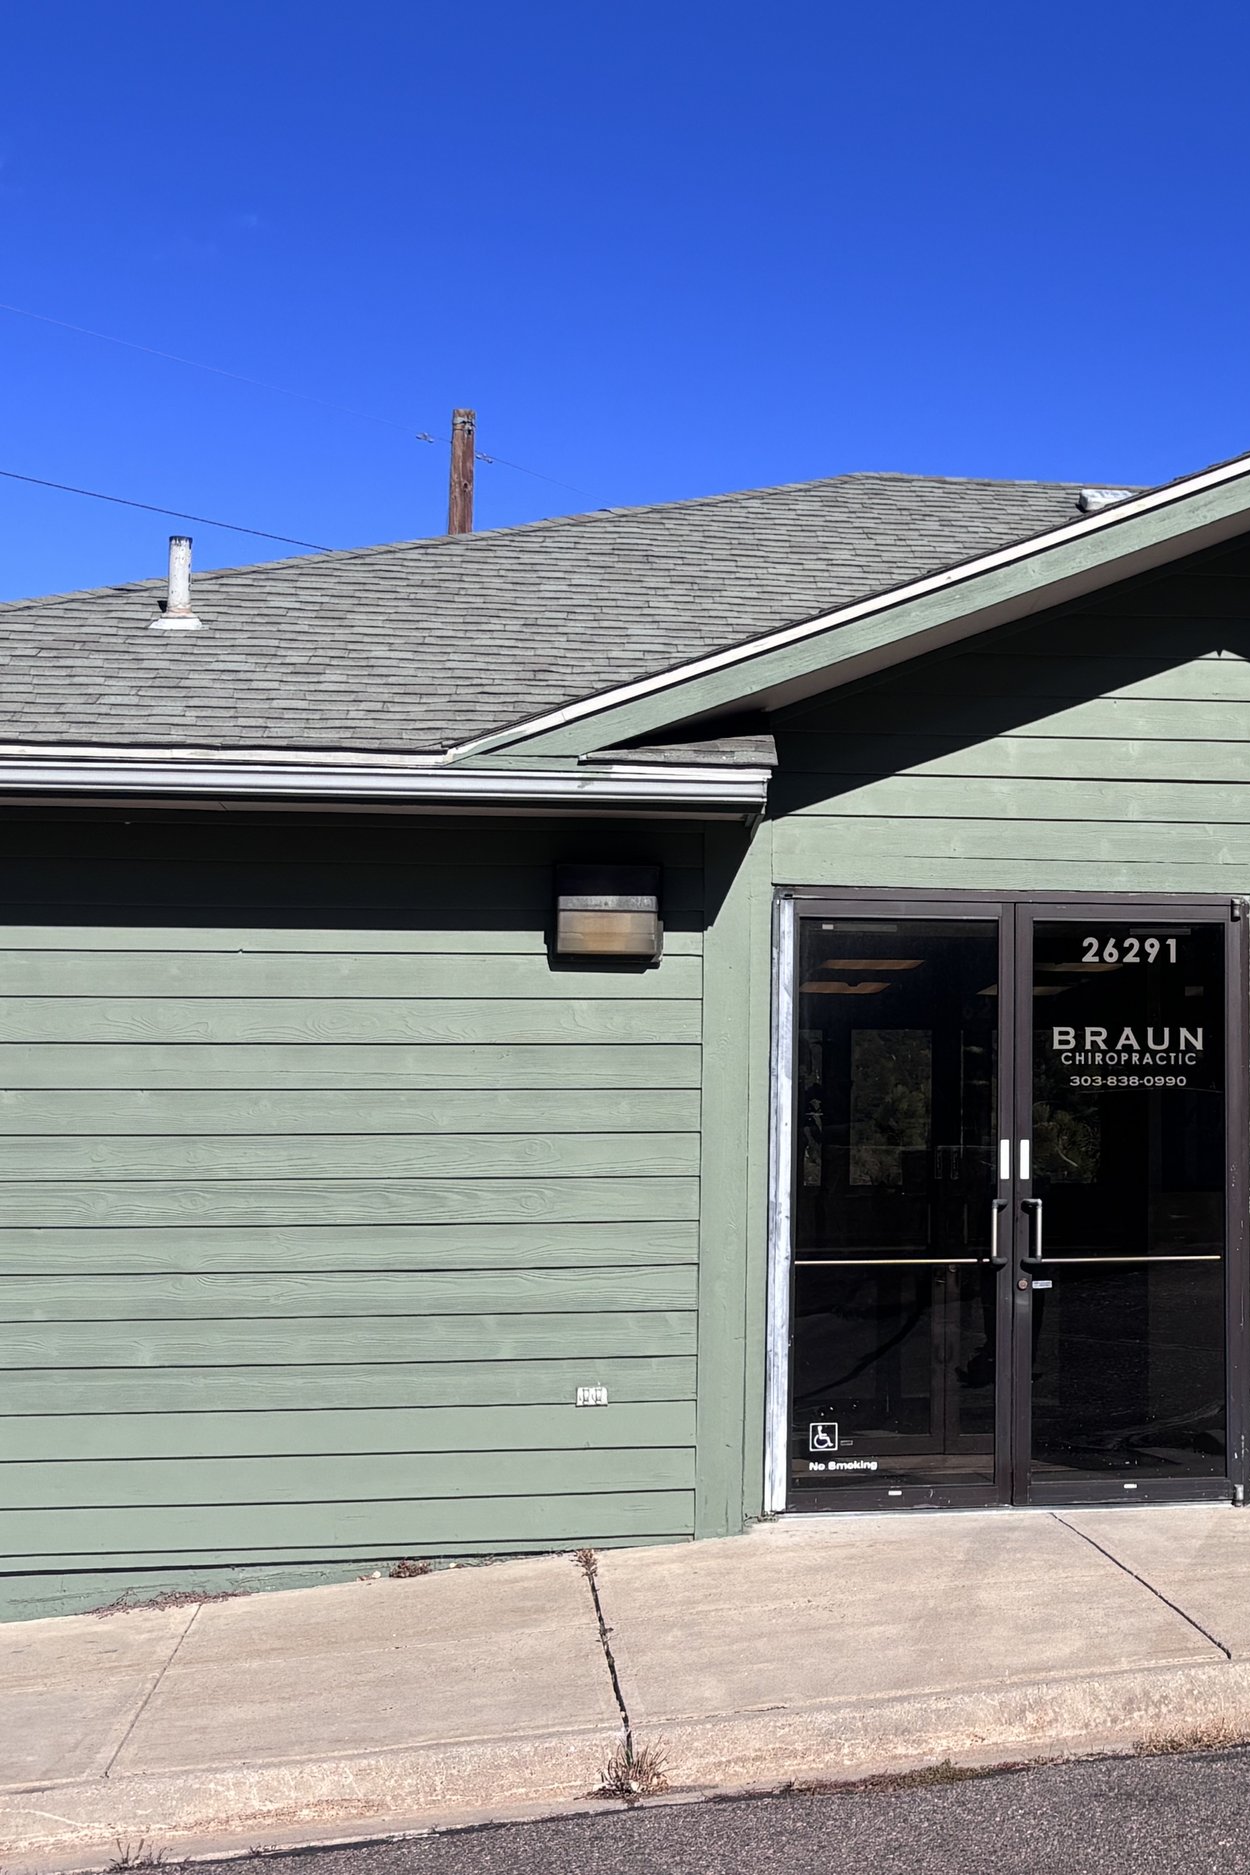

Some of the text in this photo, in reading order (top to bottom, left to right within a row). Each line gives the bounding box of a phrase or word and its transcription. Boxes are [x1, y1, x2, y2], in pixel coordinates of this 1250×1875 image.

[1081, 936, 1177, 963] 26291
[1052, 1026, 1204, 1050] BRAUN
[1061, 1052, 1197, 1065] CHIROPRACTIC
[1069, 1075, 1187, 1087] 303-838-0990
[808, 1460, 878, 1471] No Smoking
